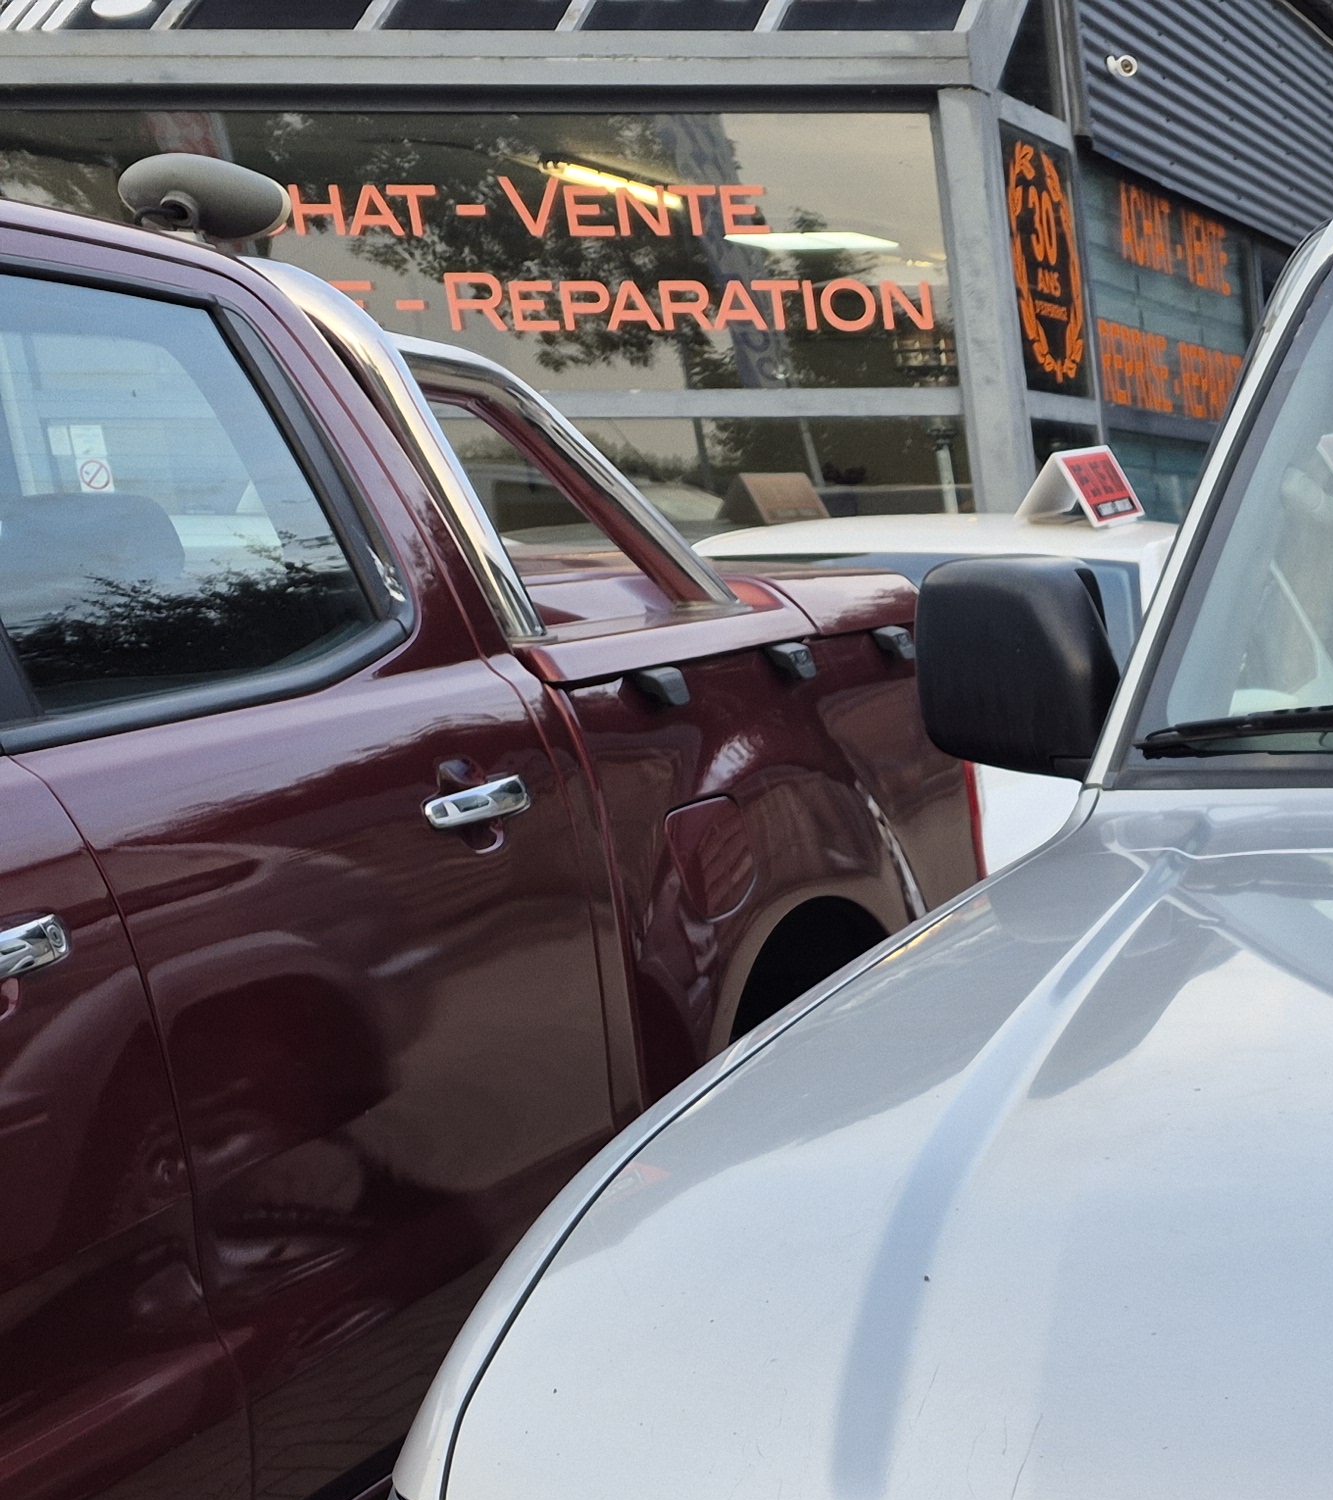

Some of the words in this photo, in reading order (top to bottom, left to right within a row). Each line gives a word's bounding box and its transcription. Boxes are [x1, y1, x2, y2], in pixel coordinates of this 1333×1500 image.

[268, 183, 436, 236] HAT
[498, 175, 772, 237] VENTE
[1028, 185, 1058, 267] 30
[1120, 181, 1174, 276] ACHAT
[1181, 207, 1232, 296] VENTE
[443, 272, 935, 332] REPARATION
[1097, 318, 1174, 414] REPRISE
